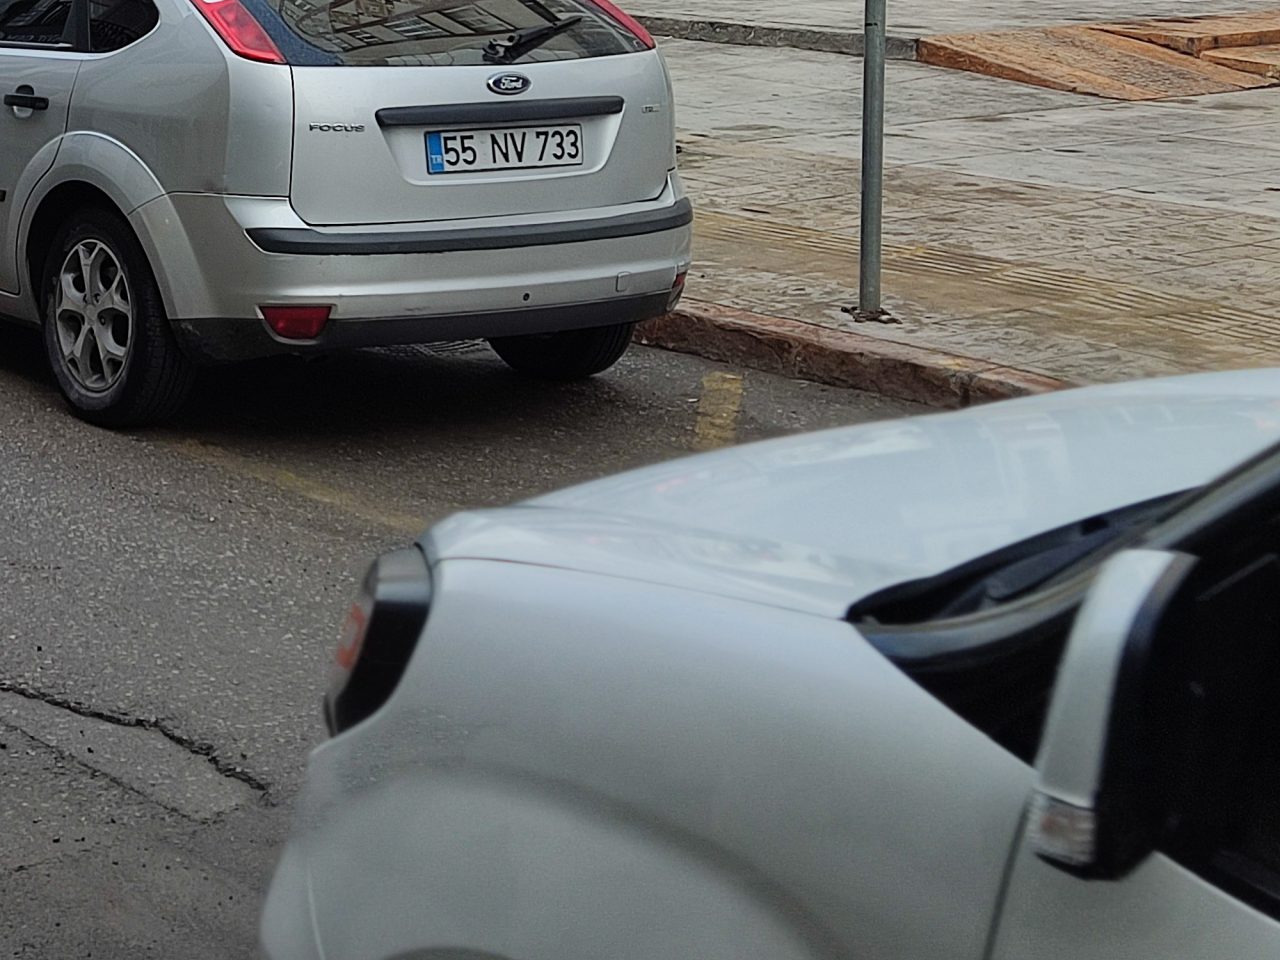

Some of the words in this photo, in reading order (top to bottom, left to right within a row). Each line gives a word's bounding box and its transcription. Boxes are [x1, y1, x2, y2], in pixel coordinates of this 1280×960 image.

[500, 76, 523, 89] Ford
[309, 123, 365, 133] FOCUS
[431, 154, 443, 164] TR
[443, 135, 477, 166] 55
[490, 131, 526, 164] NV
[535, 129, 579, 161] 733
